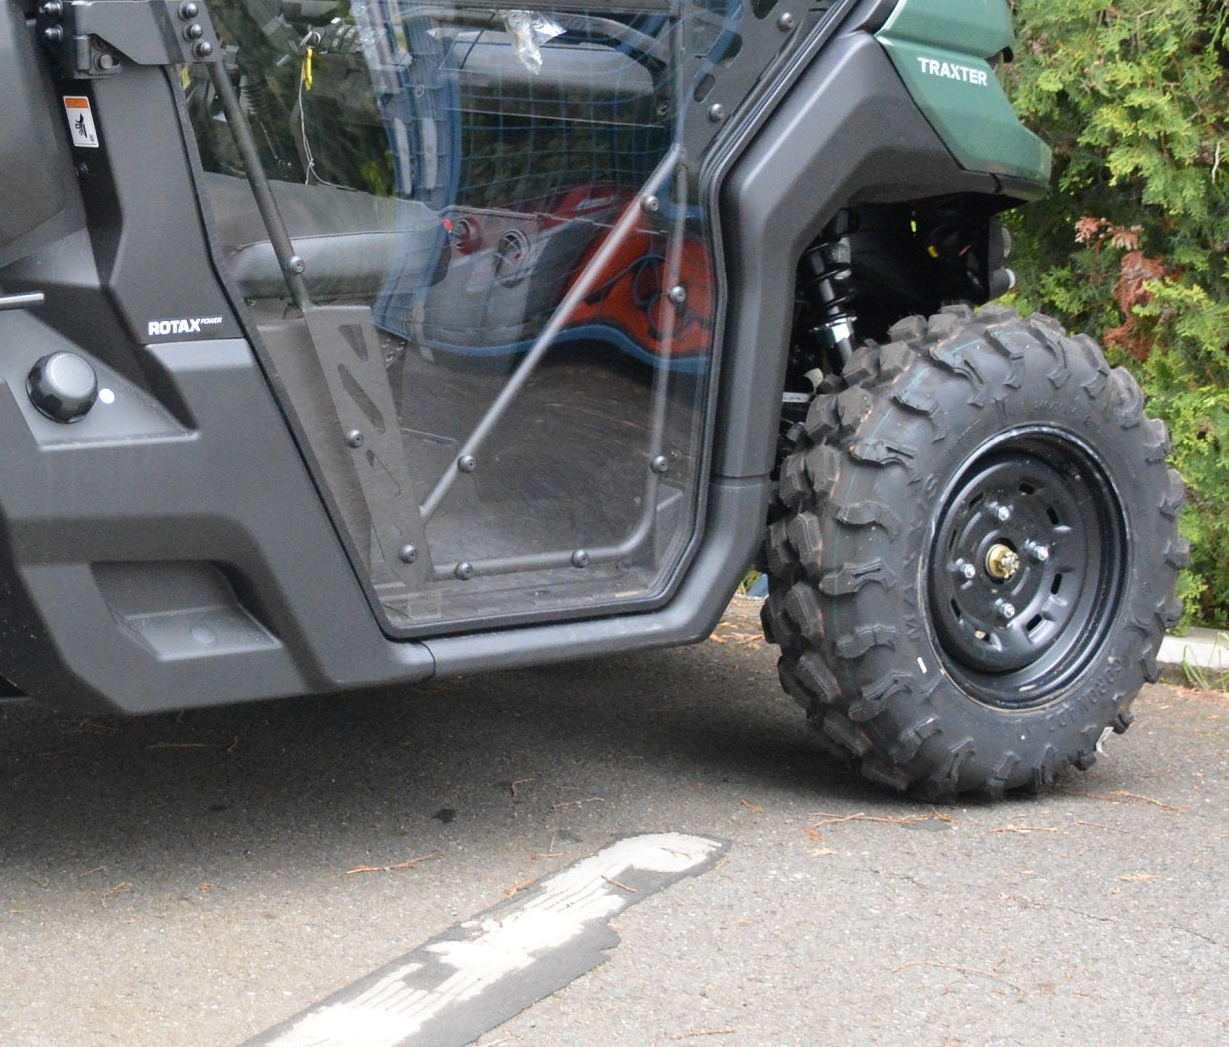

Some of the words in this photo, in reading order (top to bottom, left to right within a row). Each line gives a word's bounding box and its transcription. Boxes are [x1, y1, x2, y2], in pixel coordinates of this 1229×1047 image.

[917, 57, 988, 86] TRAXTER
[148, 318, 201, 335] ROTAX
[200, 316, 223, 324] POWER
